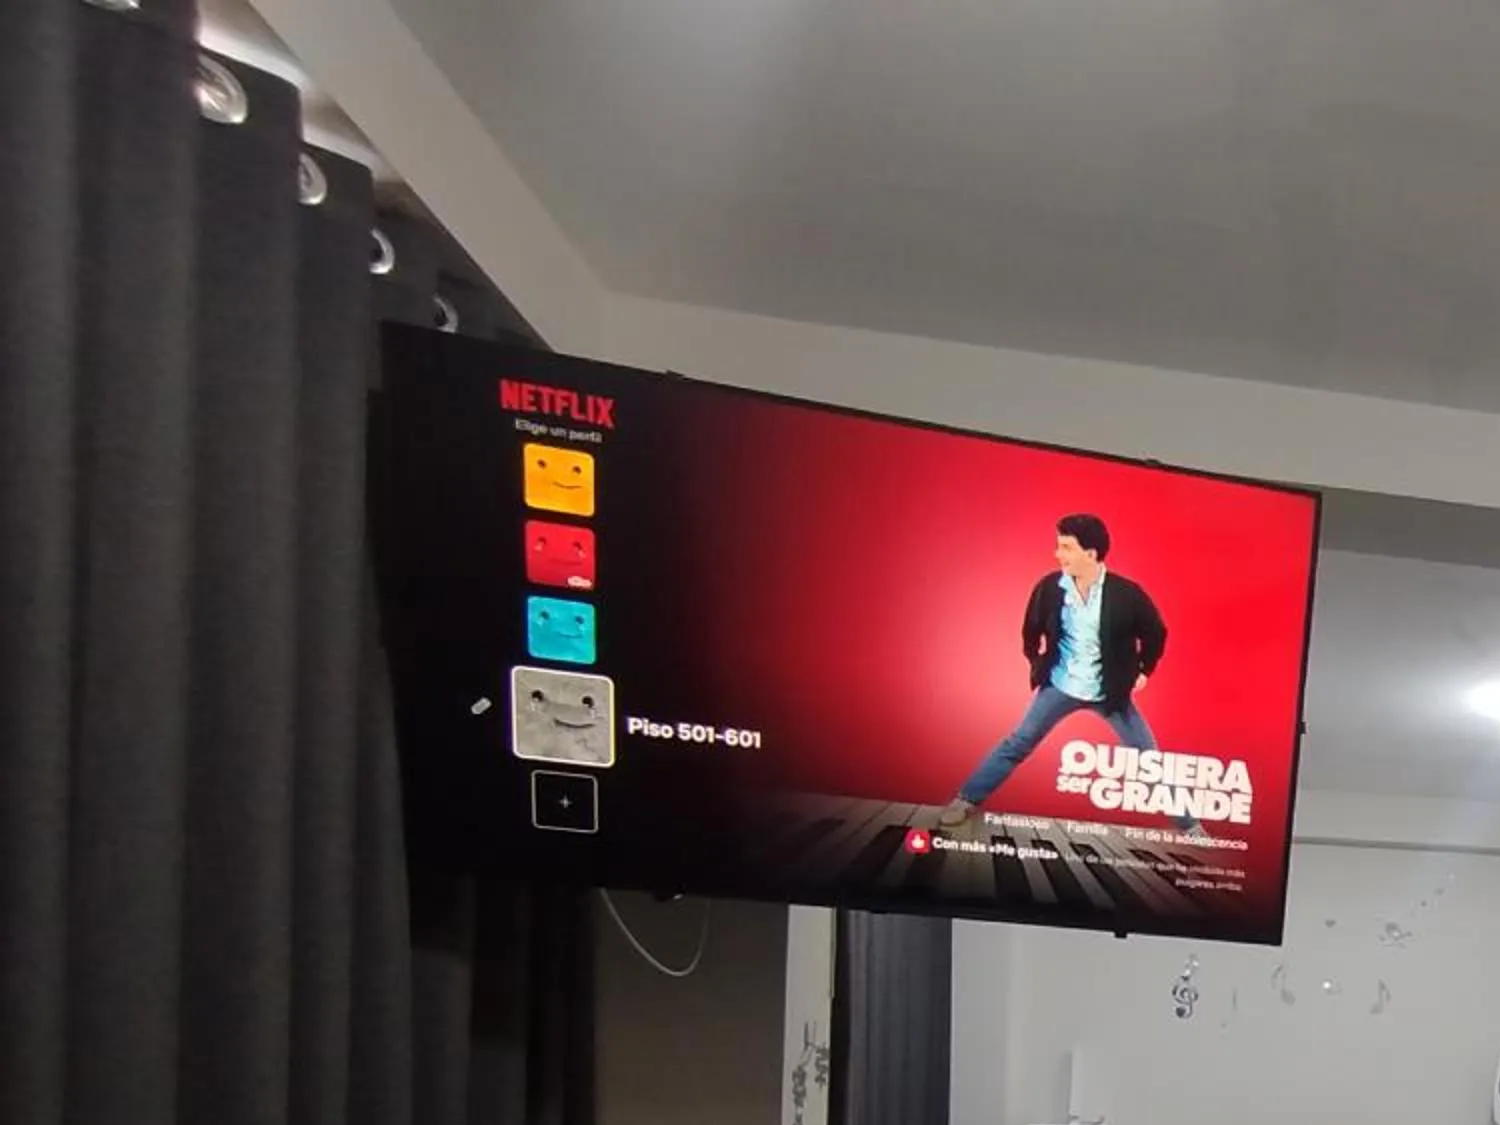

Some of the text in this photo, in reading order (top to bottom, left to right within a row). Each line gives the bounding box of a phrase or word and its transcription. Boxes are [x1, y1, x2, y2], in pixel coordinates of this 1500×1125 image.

[500, 379, 615, 430] NETFLIX
[515, 418, 548, 436] Elige
[549, 427, 567, 438] un
[627, 716, 762, 749] Piso 501-601
[1059, 740, 1252, 794] QUISIERA
[1056, 775, 1251, 824] ser GRANDE
[932, 837, 959, 850] Con
[962, 839, 987, 852] más
[1146, 830, 1161, 842] de
[1163, 831, 1173, 843] la
[1175, 834, 1248, 851] adolescencia
